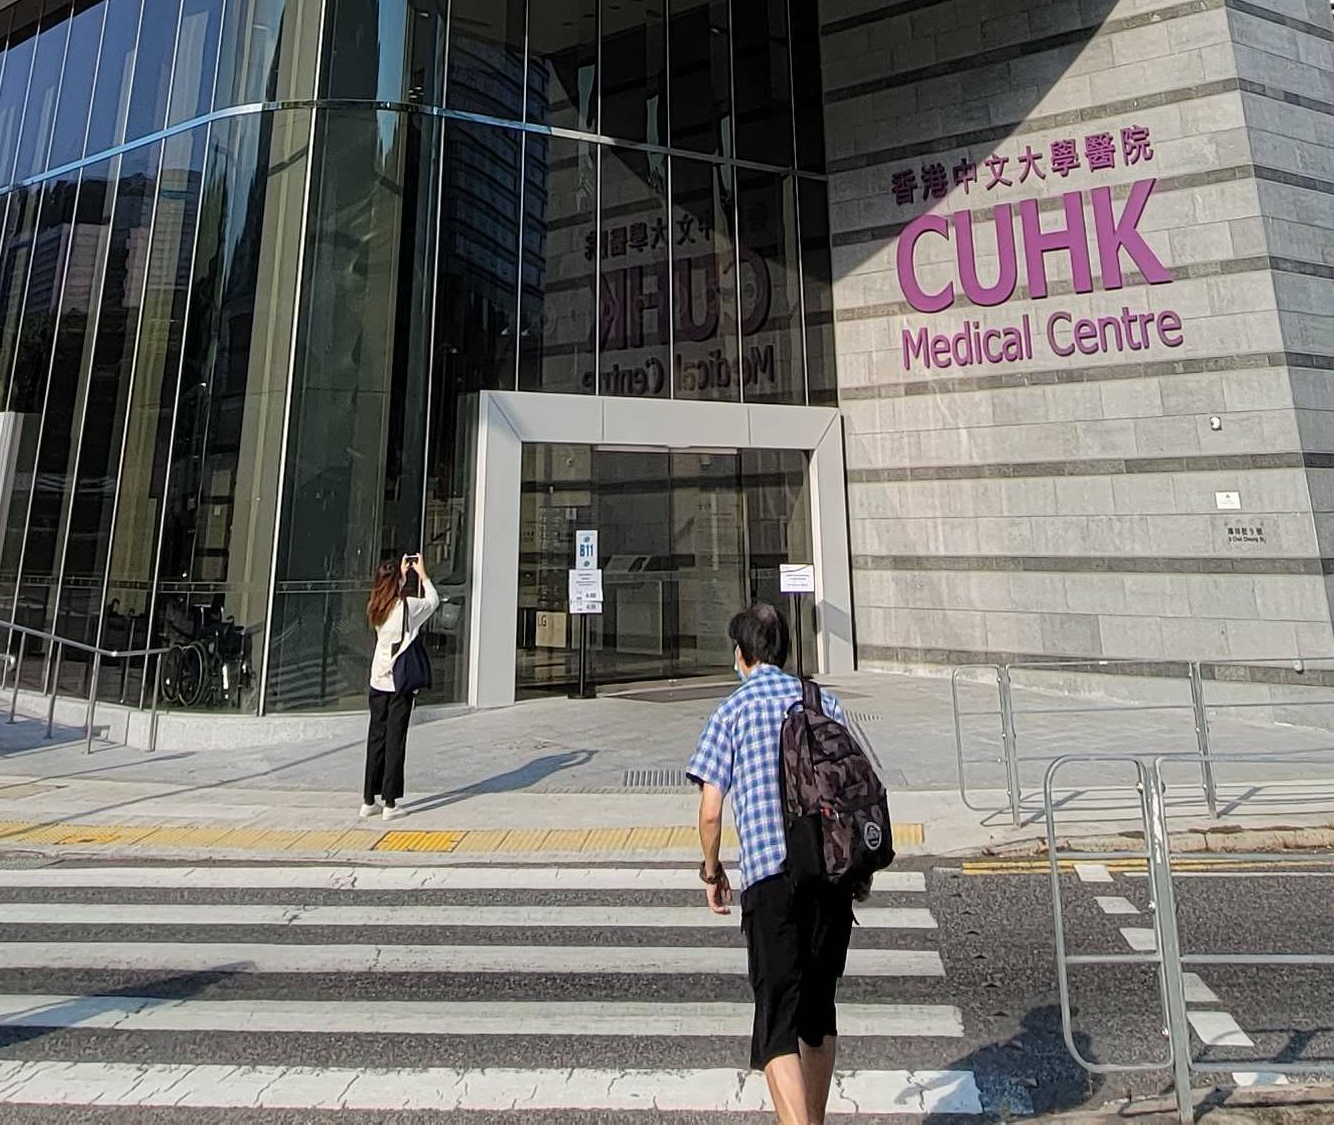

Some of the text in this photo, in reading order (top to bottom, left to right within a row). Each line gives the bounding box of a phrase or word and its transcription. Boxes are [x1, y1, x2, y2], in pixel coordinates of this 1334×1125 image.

[891, 125, 1154, 206] 香港中文大學醫院
[896, 178, 1174, 313] CUHK
[901, 306, 1184, 371] Medical Centre
[579, 543, 594, 558] B11
